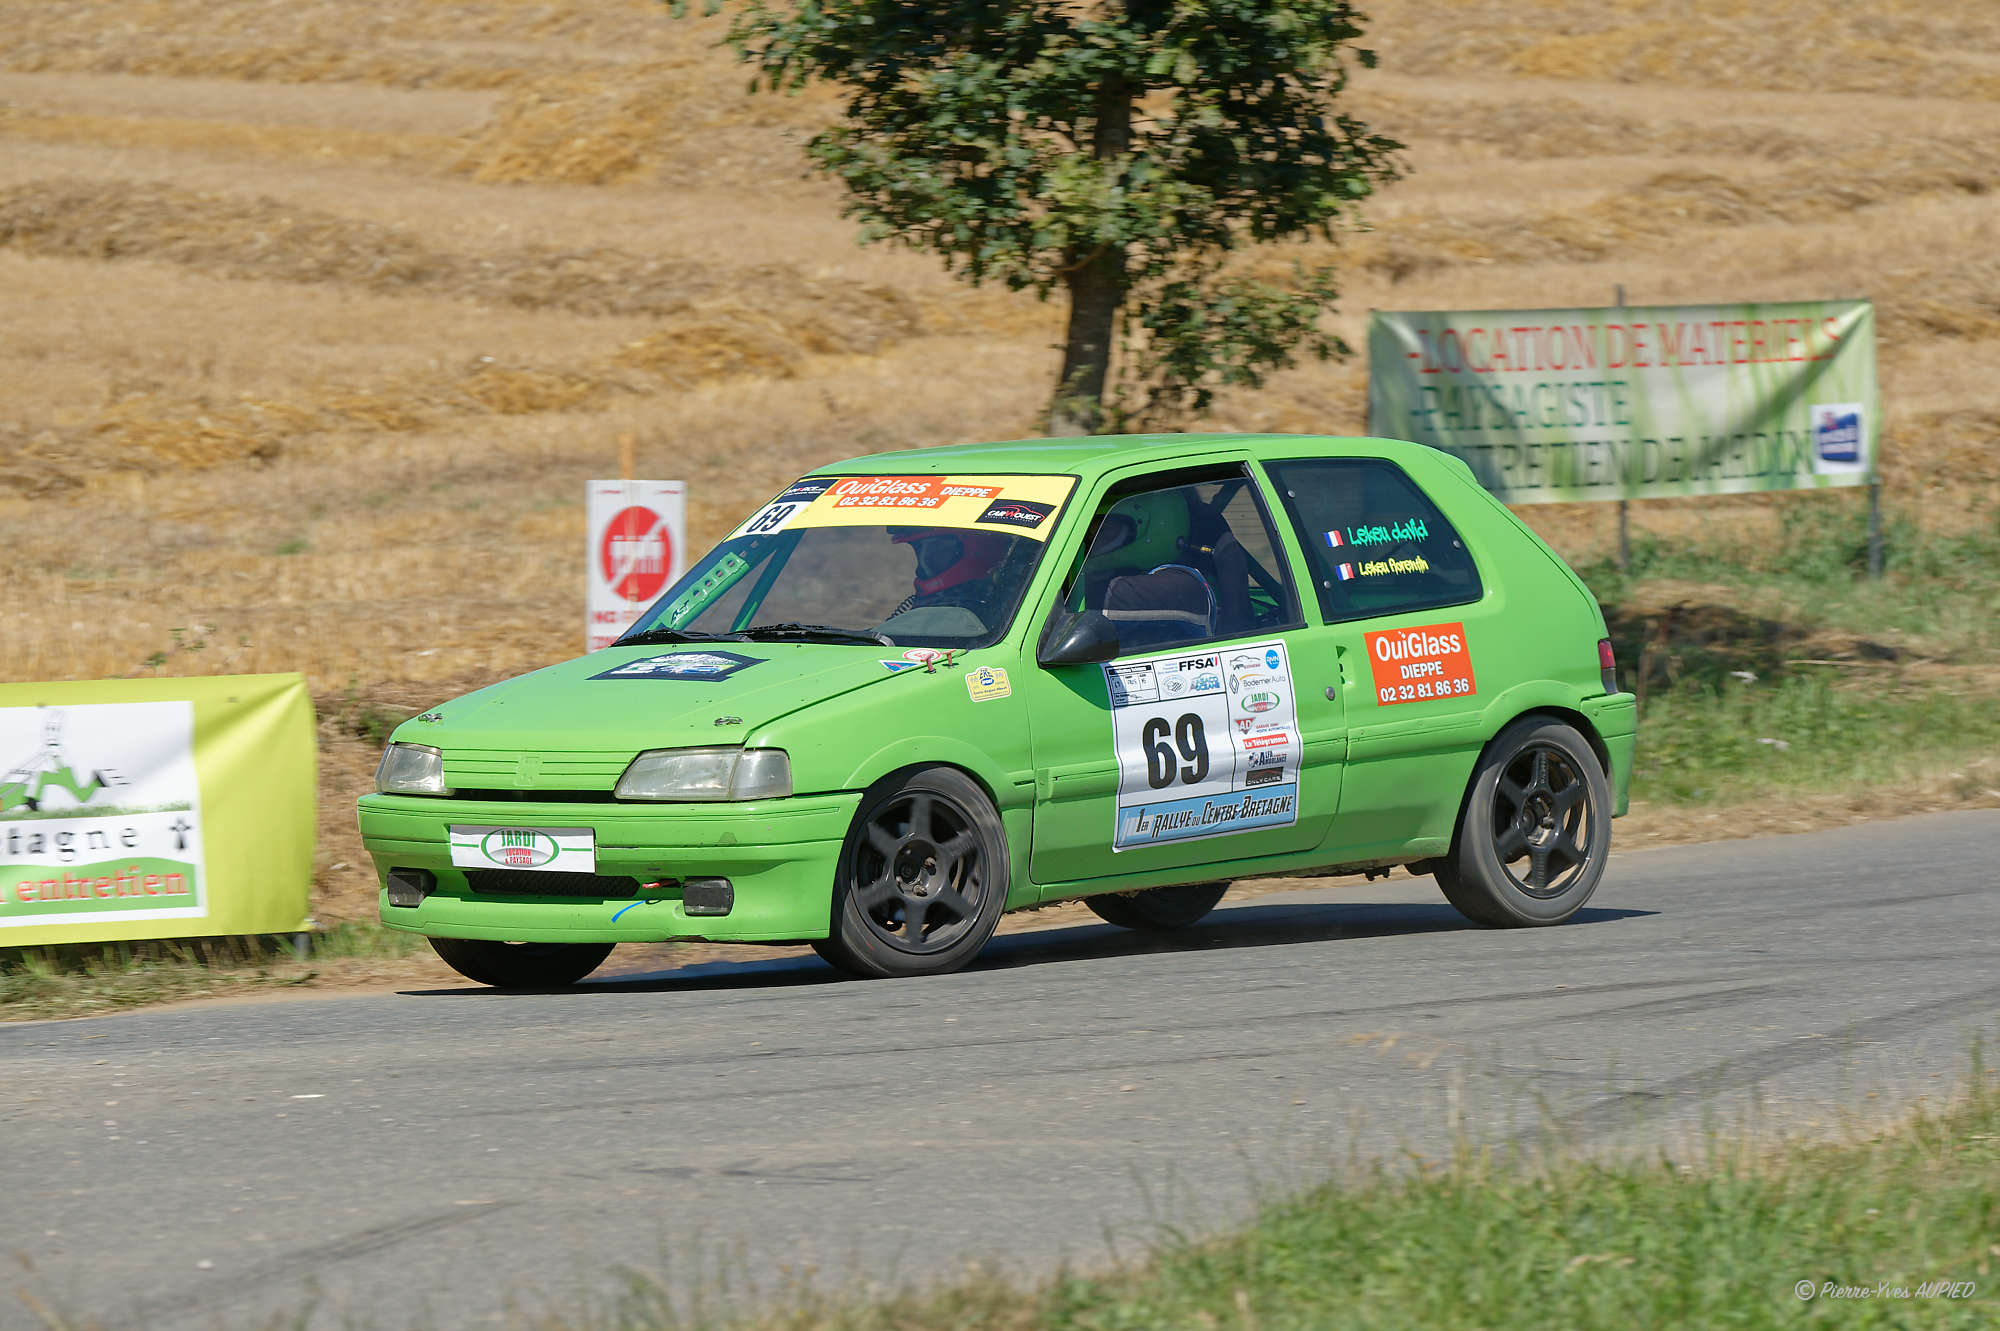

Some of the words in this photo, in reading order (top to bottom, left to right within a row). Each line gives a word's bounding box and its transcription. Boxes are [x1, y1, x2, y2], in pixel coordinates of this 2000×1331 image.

[1605, 323, 1651, 368] DE
[836, 478, 931, 495] OuiGlass
[940, 486, 992, 499] DIEPPE
[840, 496, 858, 506] 02
[860, 496, 878, 506] 32
[880, 496, 900, 506] 81
[900, 497, 918, 507] 86
[920, 497, 939, 507] 36
[746, 504, 797, 533] 69
[1391, 518, 1429, 543] david
[1358, 561, 1390, 577] Lekeu
[1375, 631, 1462, 662] OuiGlass
[1178, 657, 1214, 672] FFSA
[1400, 661, 1444, 679] DIEPPE
[1380, 687, 1397, 702] 02
[1399, 685, 1416, 700] 32
[1417, 683, 1434, 697] 81
[1435, 681, 1452, 695] 86
[1453, 678, 1470, 693] 36
[1239, 719, 1252, 730] AD
[1142, 713, 1210, 790] 69
[1151, 810, 1193, 839] RALLYE
[0, 827, 138, 862] tagne
[501, 829, 536, 848] JARDI
[506, 848, 532, 857] LOCATION
[510, 856, 532, 865] PAYSAGE
[15, 866, 190, 902] entretien
